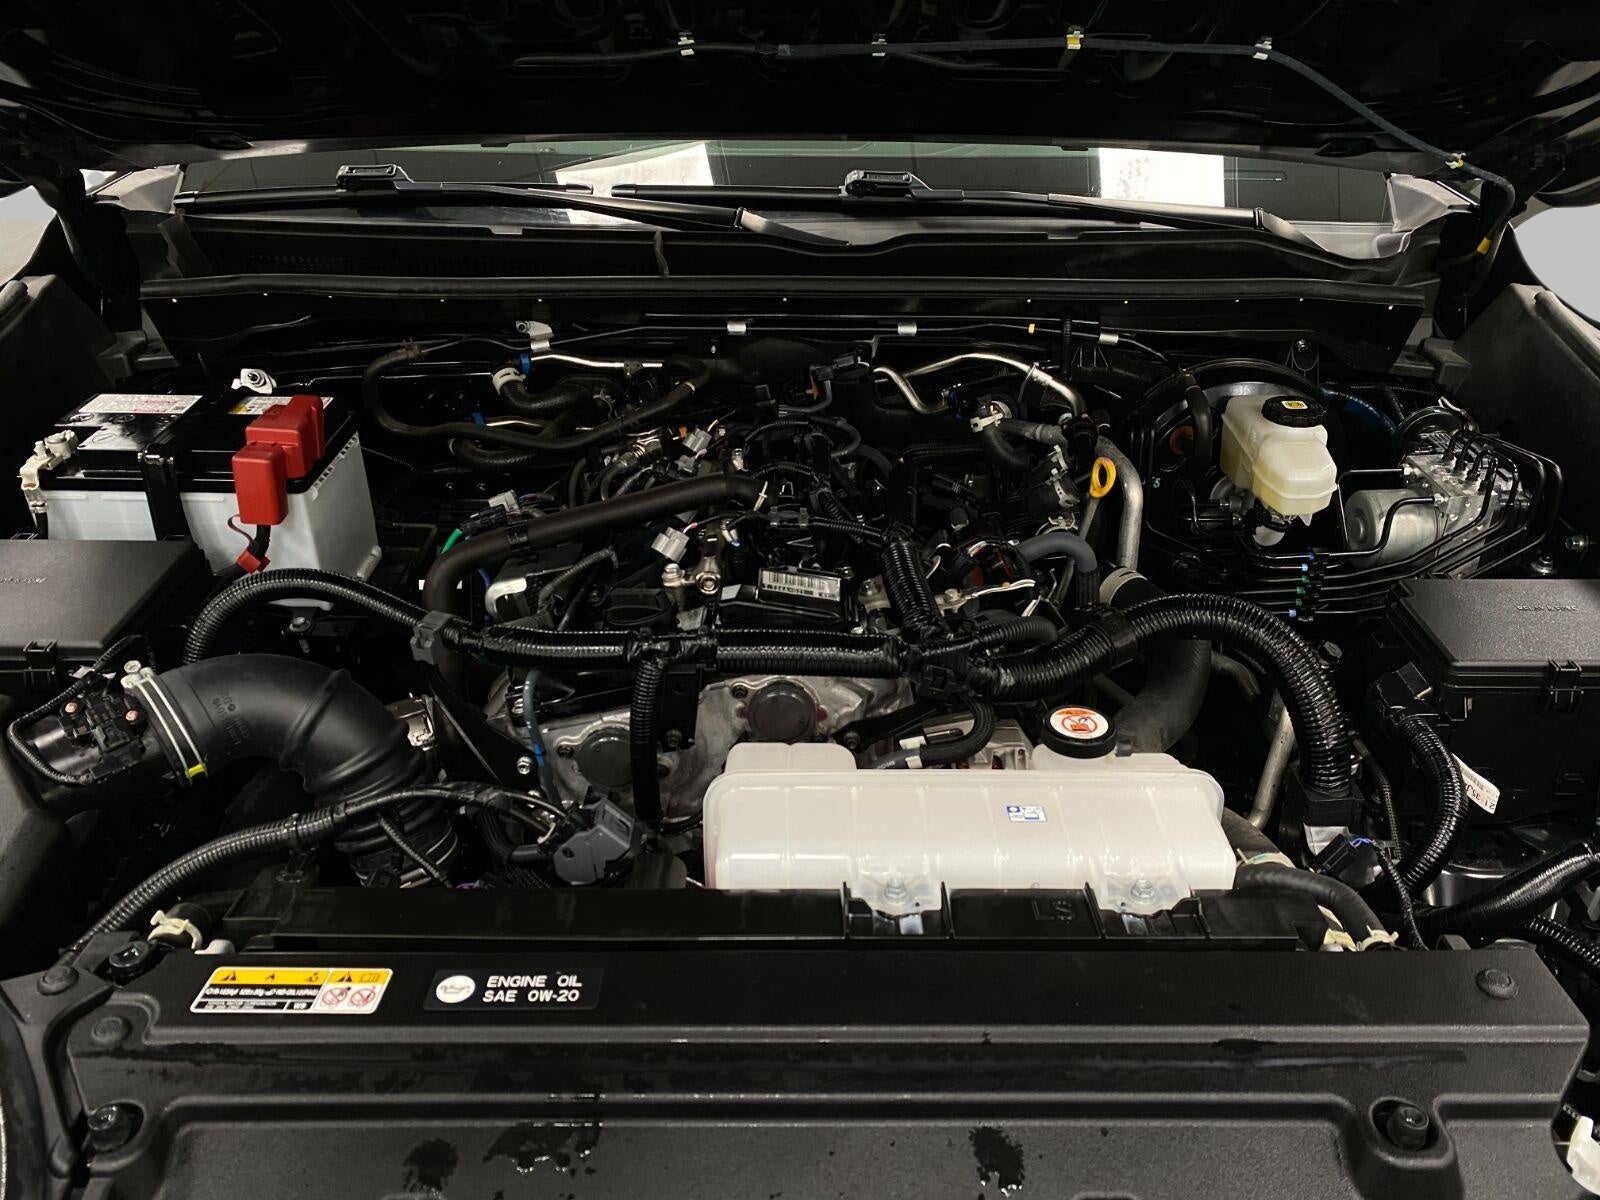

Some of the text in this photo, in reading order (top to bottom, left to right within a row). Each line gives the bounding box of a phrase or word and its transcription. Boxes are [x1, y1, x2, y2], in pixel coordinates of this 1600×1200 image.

[486, 974, 583, 988] ENGINE OIL
[482, 989, 580, 1003] SAE 0W-20
